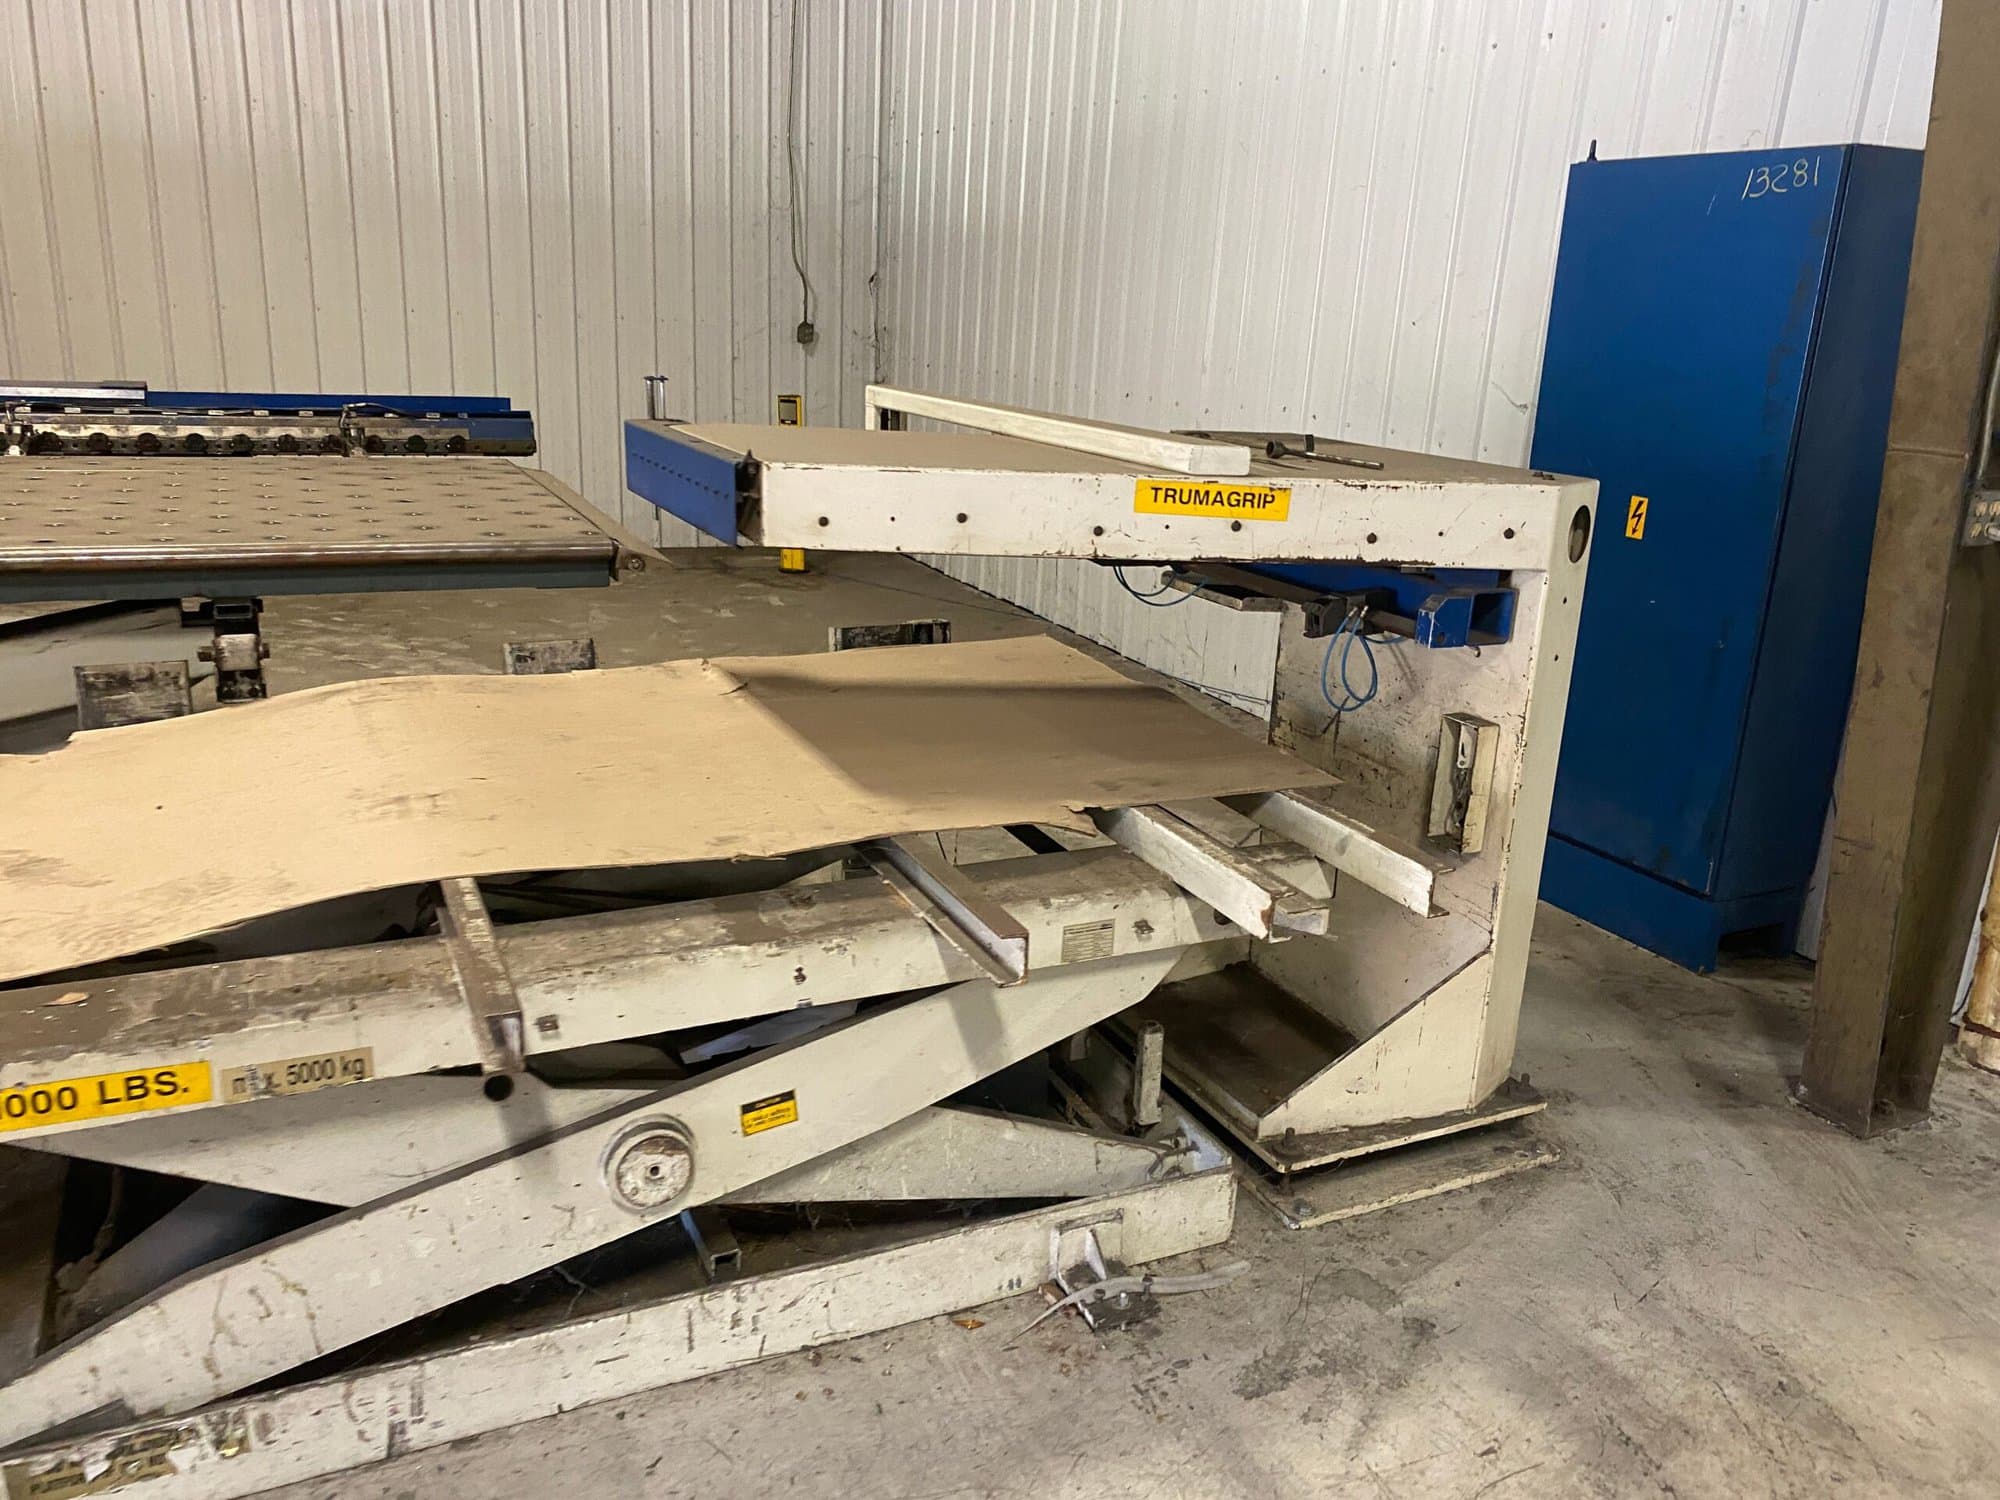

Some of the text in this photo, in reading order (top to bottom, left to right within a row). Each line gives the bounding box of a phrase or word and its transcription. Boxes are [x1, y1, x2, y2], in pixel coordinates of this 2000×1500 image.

[1741, 155, 1820, 200] 13281
[1151, 487, 1276, 509] TRUMAGRIP
[0, 1070, 190, 1119] 000 LBS.
[232, 1056, 365, 1095] mx. 5000 kg
